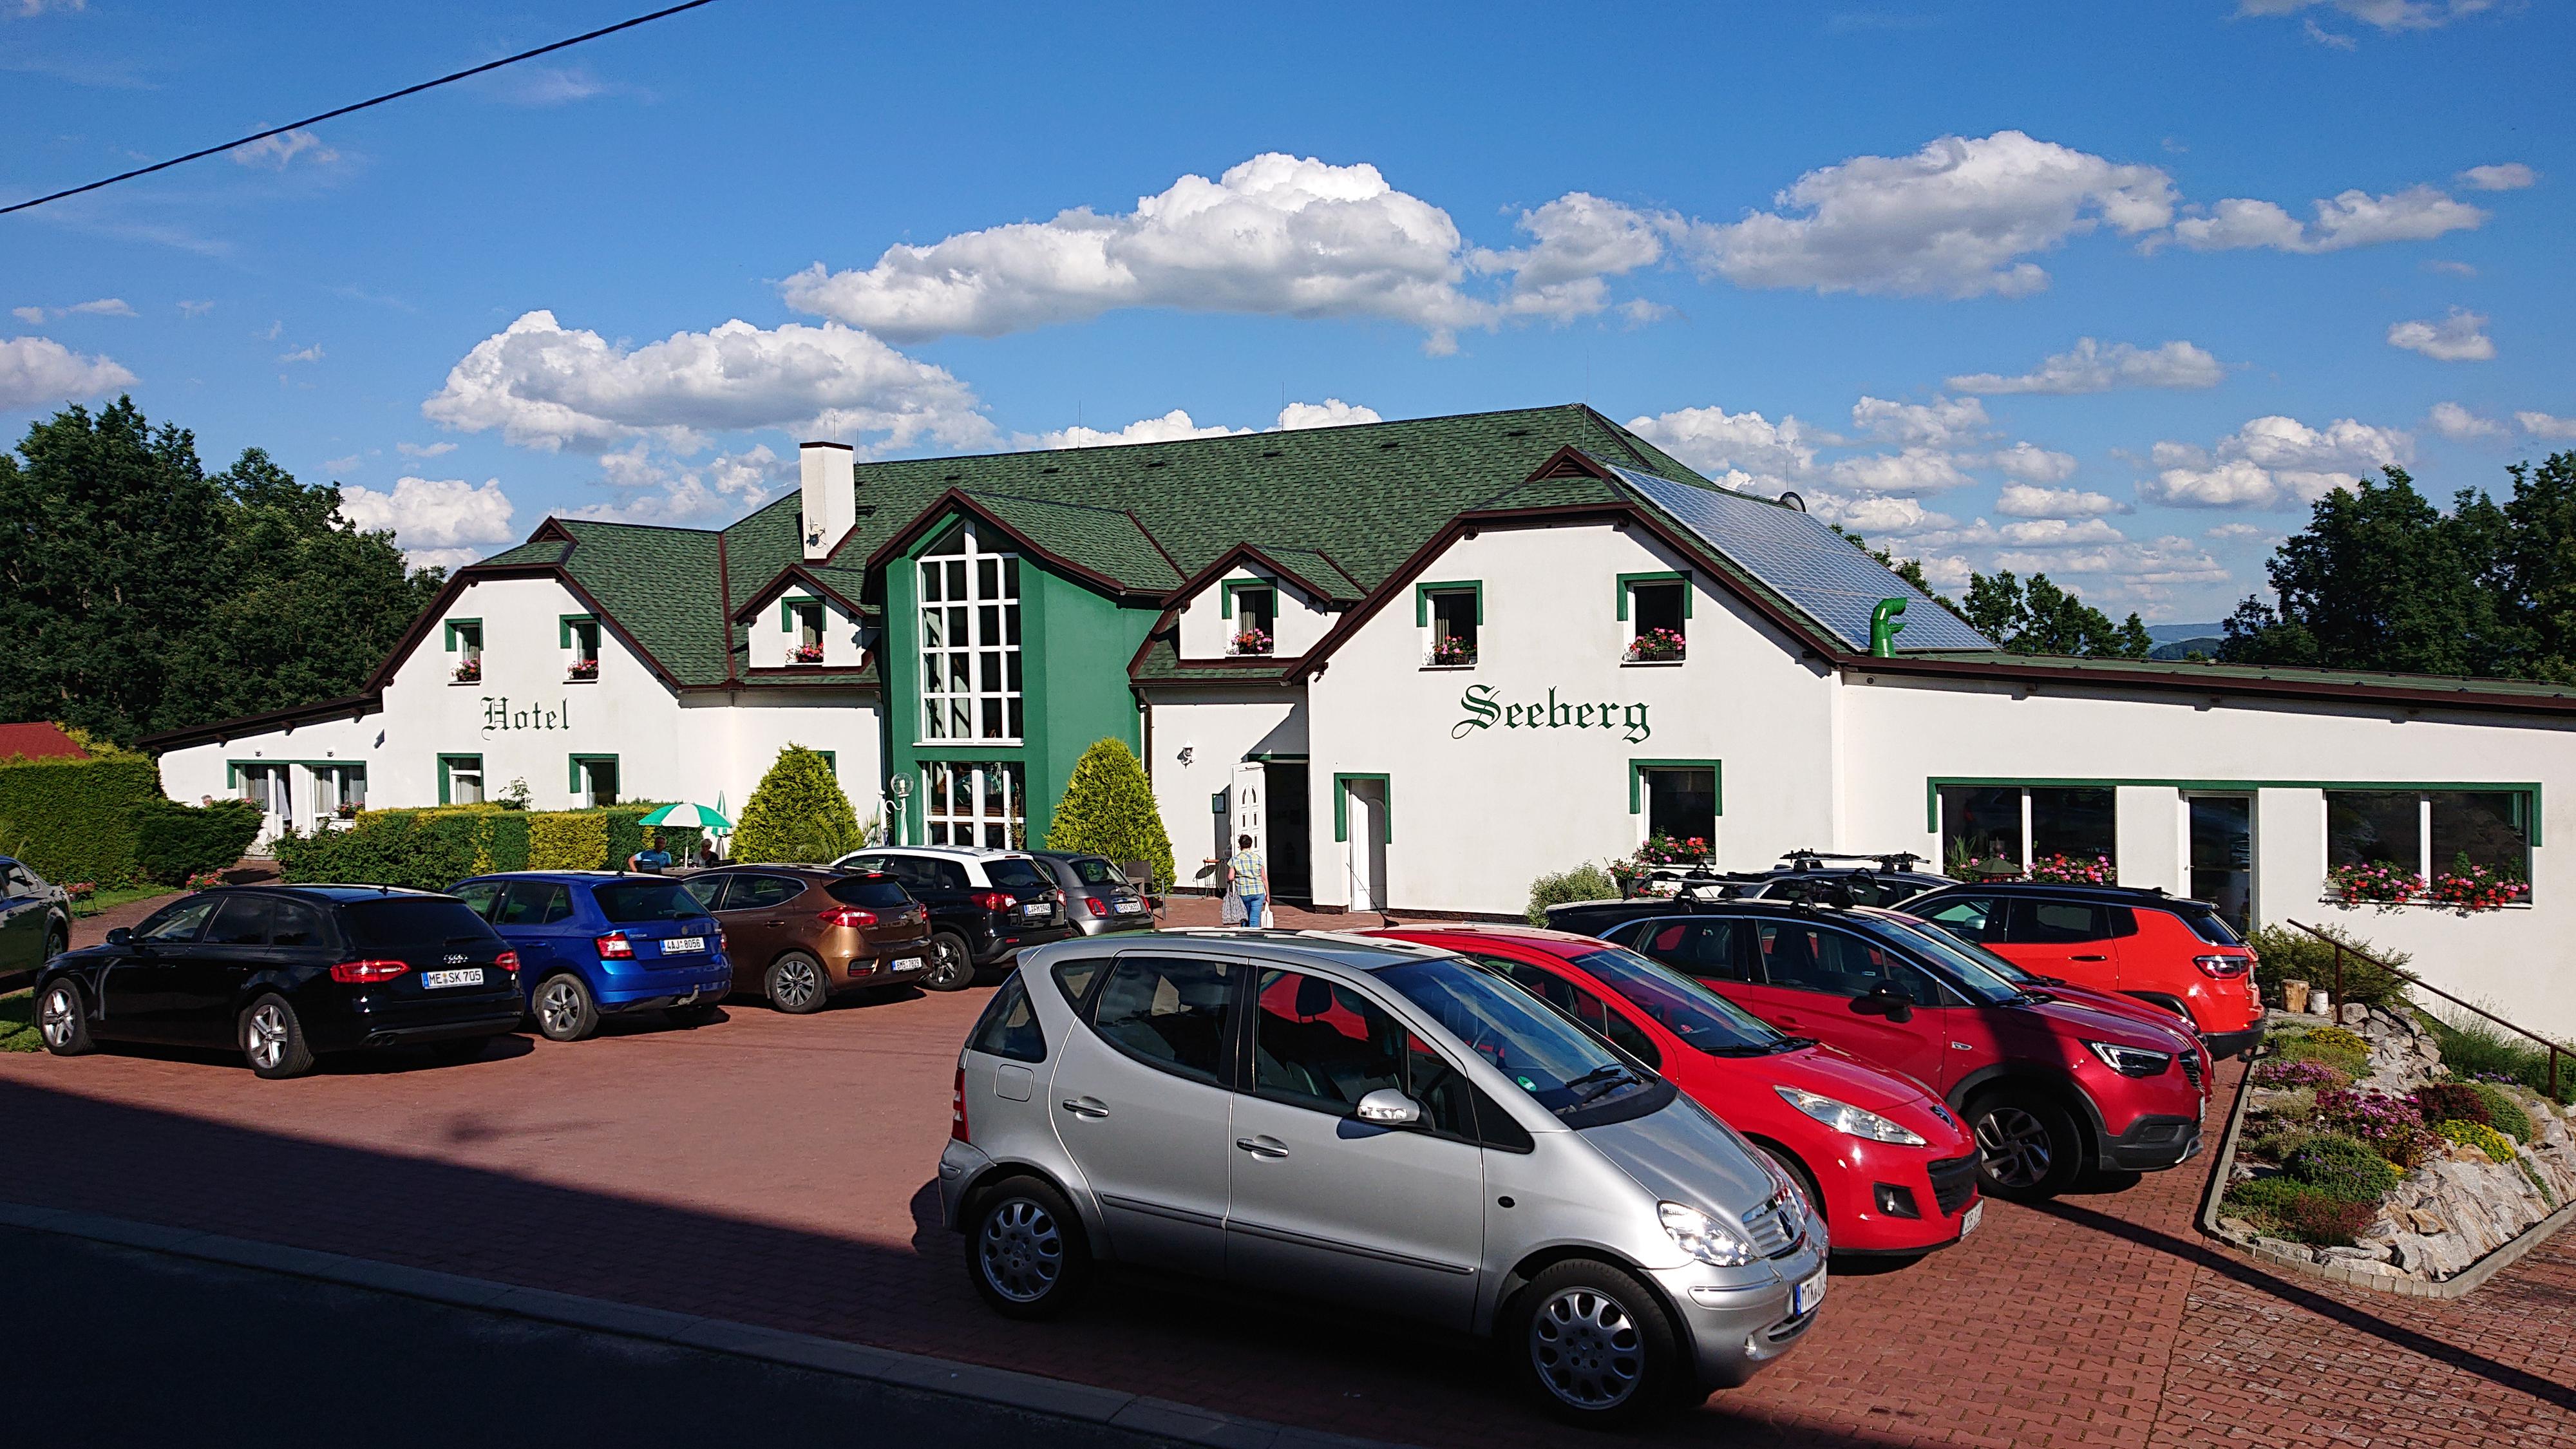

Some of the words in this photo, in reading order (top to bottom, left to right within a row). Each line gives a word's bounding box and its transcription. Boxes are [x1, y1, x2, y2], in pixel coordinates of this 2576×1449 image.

[480, 696, 571, 741] Hotel
[1451, 684, 1651, 744] Seeberg
[667, 940, 681, 950] 4AJ
[685, 939, 701, 949] 8056
[428, 973, 442, 985] ME
[448, 971, 461, 983] SK
[462, 970, 482, 981] 705
[1801, 1282, 1815, 1309] MTK
